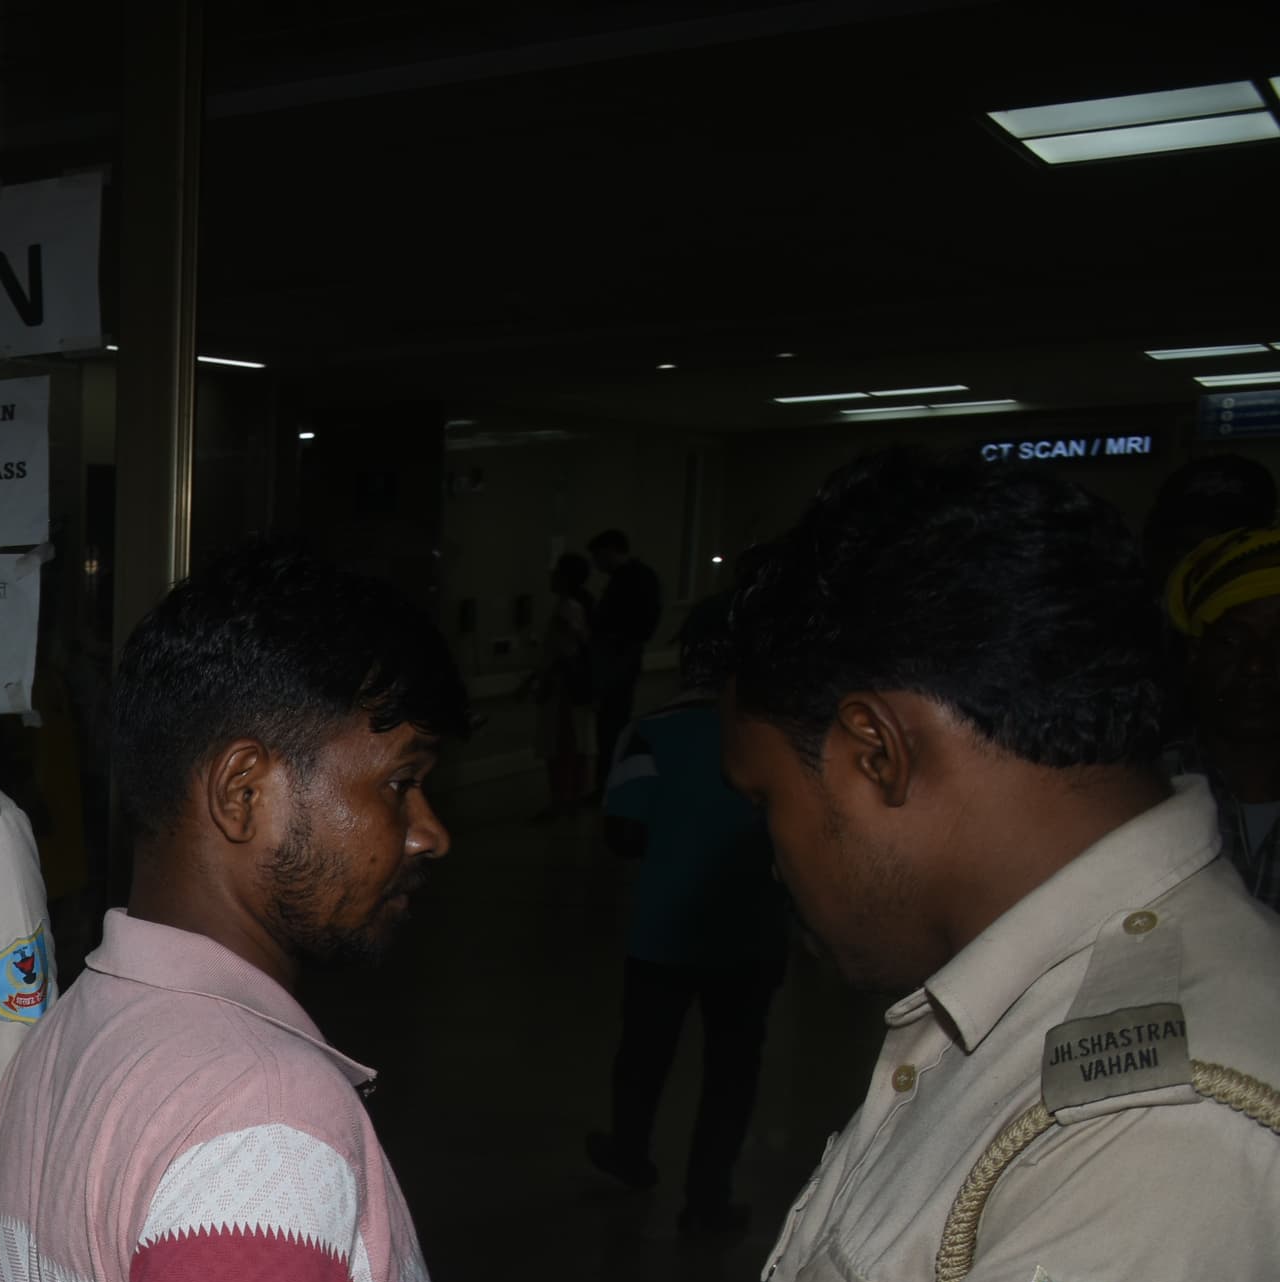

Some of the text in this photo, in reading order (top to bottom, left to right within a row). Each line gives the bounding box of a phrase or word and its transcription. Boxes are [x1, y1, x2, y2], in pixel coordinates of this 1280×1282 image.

[981, 442, 1014, 462] CT
[1018, 440, 1086, 460] SCAN
[1105, 436, 1153, 456] MRI
[1080, 1047, 1159, 1082] VAHANI
